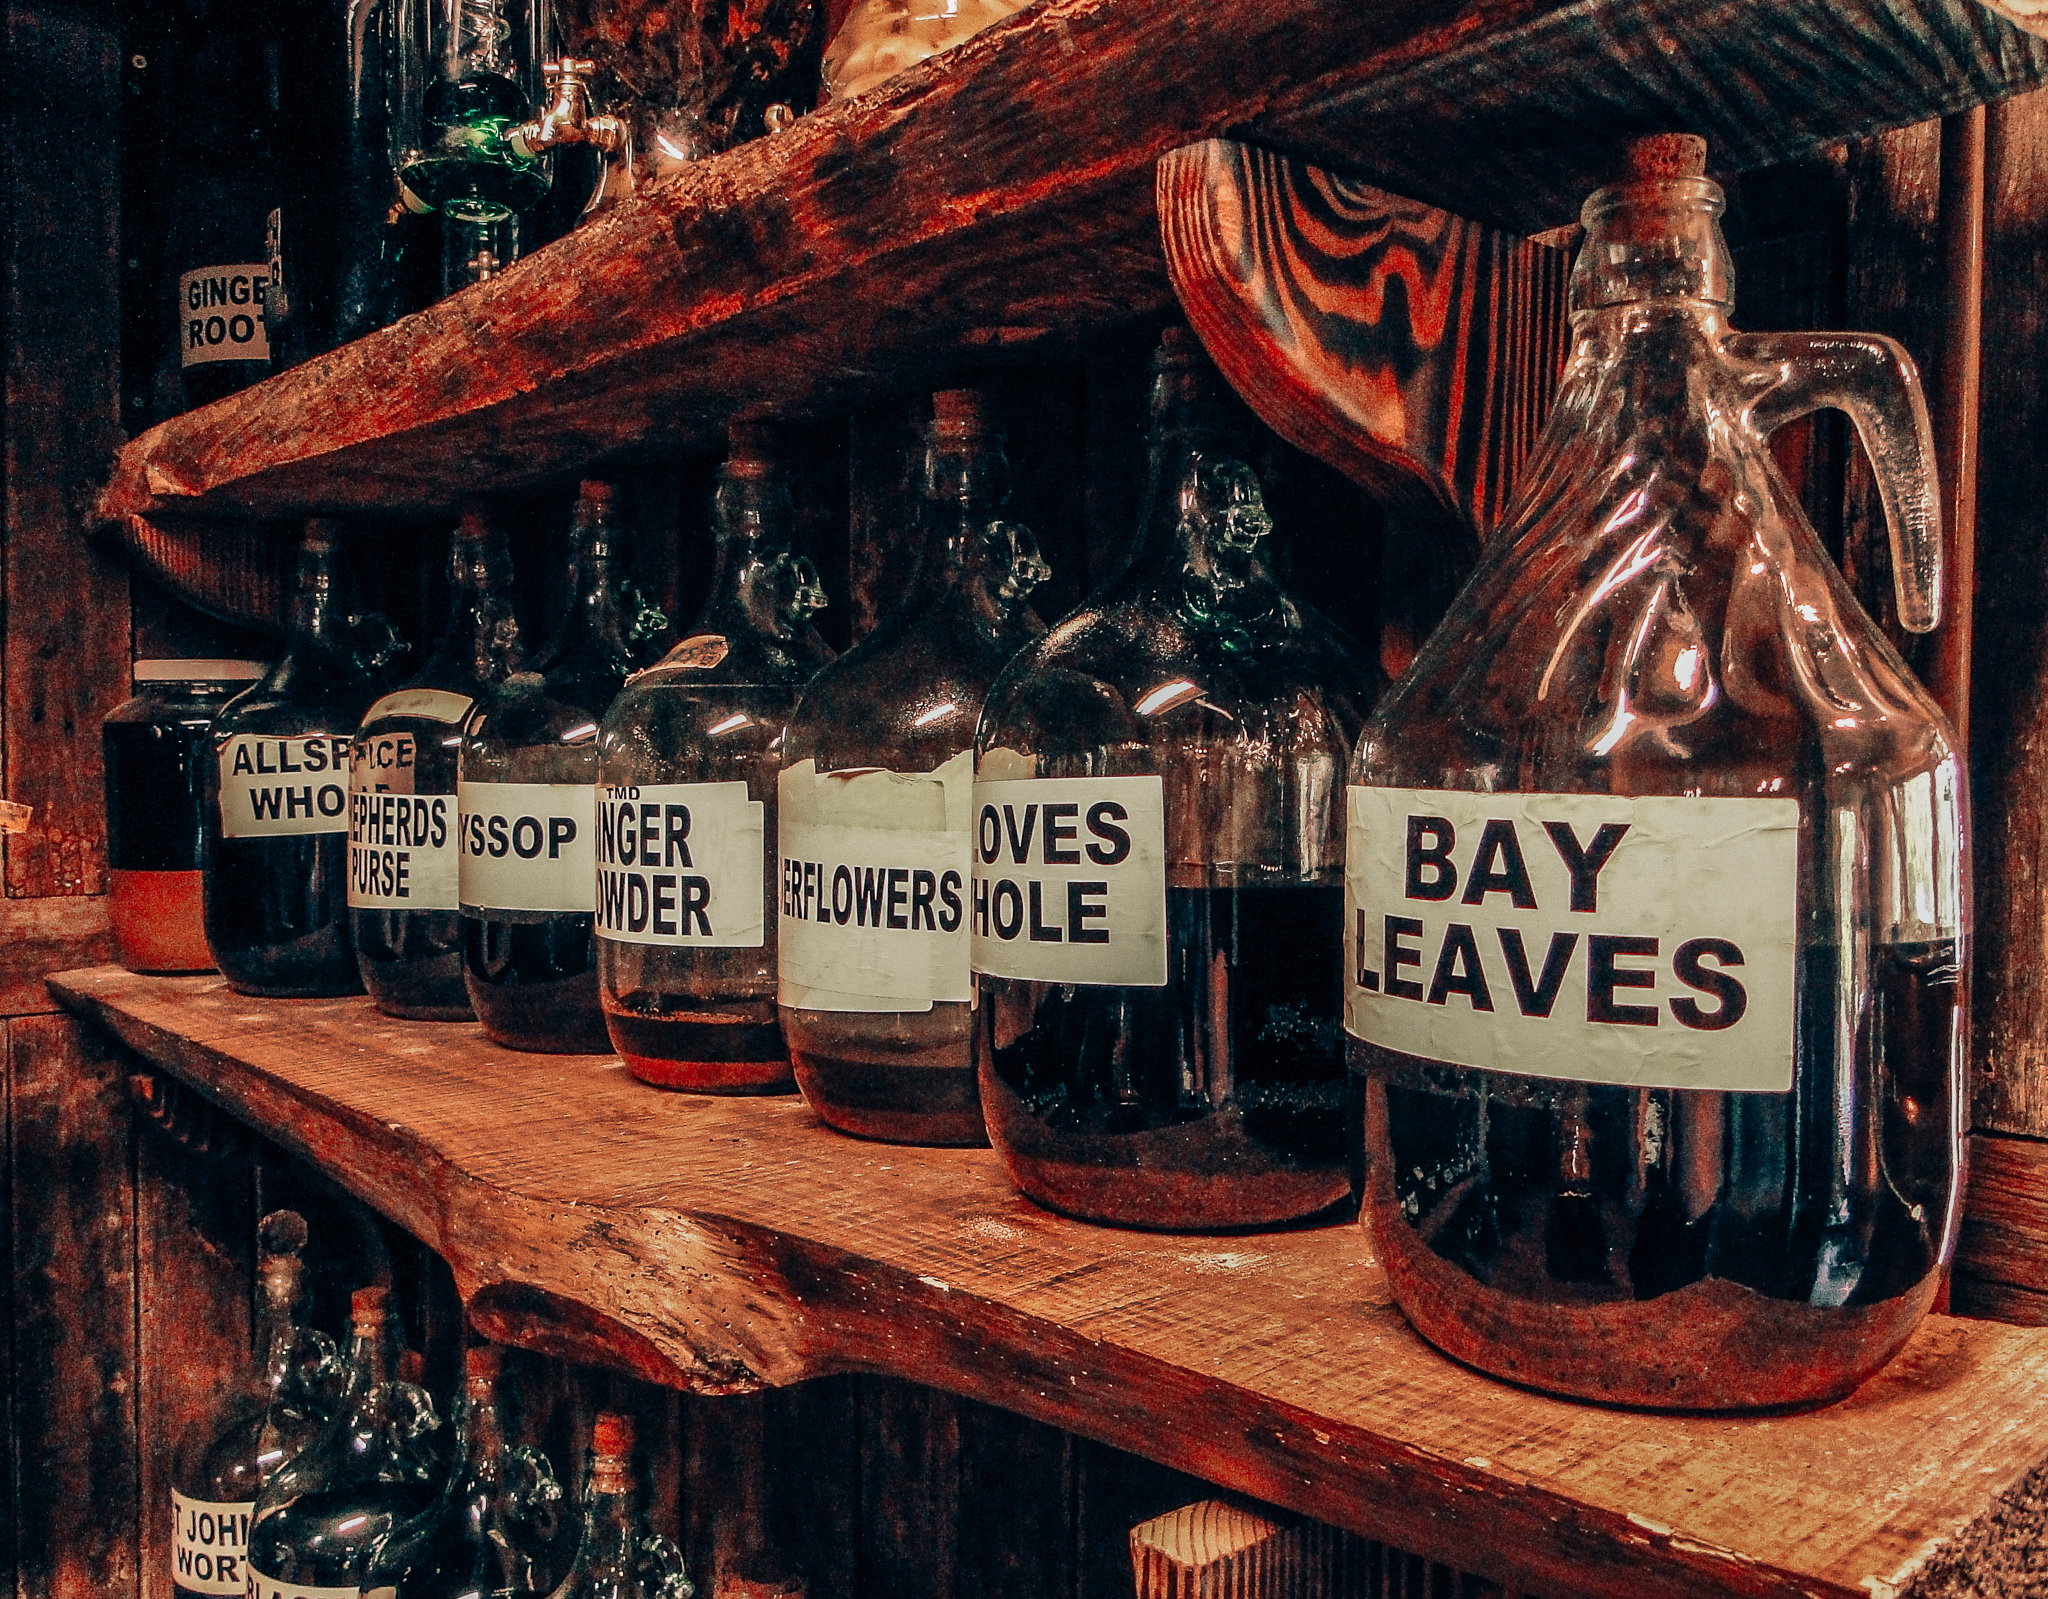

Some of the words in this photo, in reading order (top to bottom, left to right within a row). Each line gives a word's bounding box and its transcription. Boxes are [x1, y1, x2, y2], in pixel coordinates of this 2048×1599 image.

[349, 794, 447, 848] EPHERDS
[458, 812, 578, 859] YSSOP
[595, 801, 694, 868] INGER
[974, 802, 1132, 866] OVES
[352, 847, 411, 897] PURSE
[780, 856, 963, 933] ERFLOWERS
[1404, 815, 1631, 913] BAY
[971, 878, 1111, 945] HOLE
[1355, 908, 1748, 1031] LEAVES
